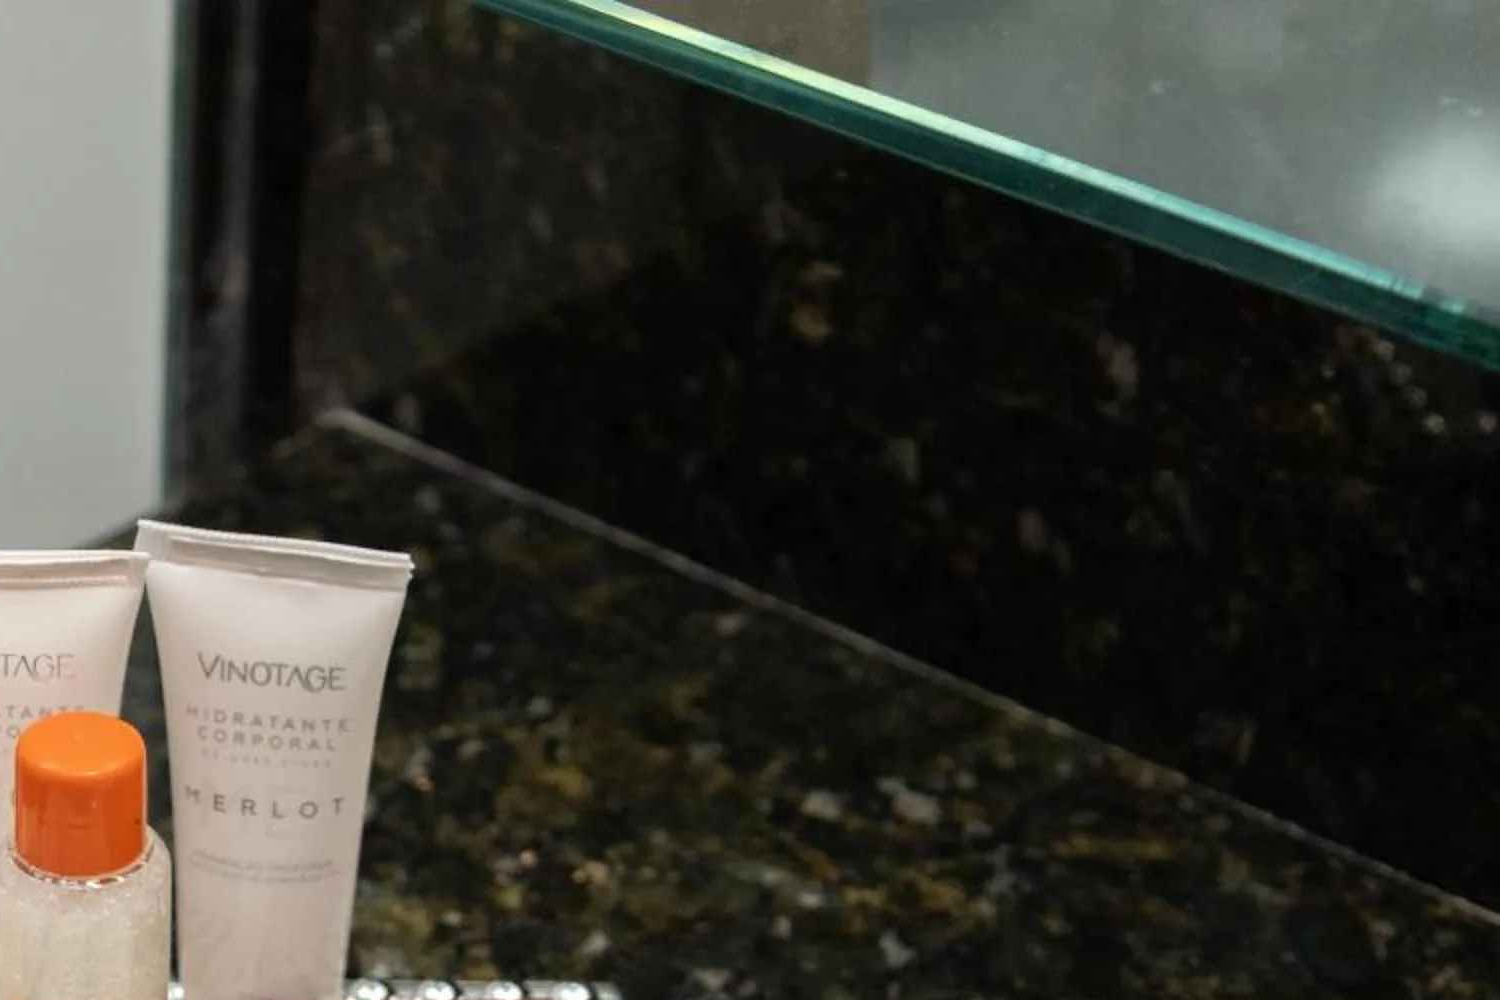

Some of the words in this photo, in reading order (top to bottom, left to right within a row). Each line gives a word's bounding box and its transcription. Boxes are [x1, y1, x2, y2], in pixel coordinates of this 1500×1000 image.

[197, 651, 348, 693] VINOTAGE
[185, 703, 350, 733] HIDRATANTE
[197, 727, 337, 751] CORPORAL
[185, 785, 347, 819] MERLOT
